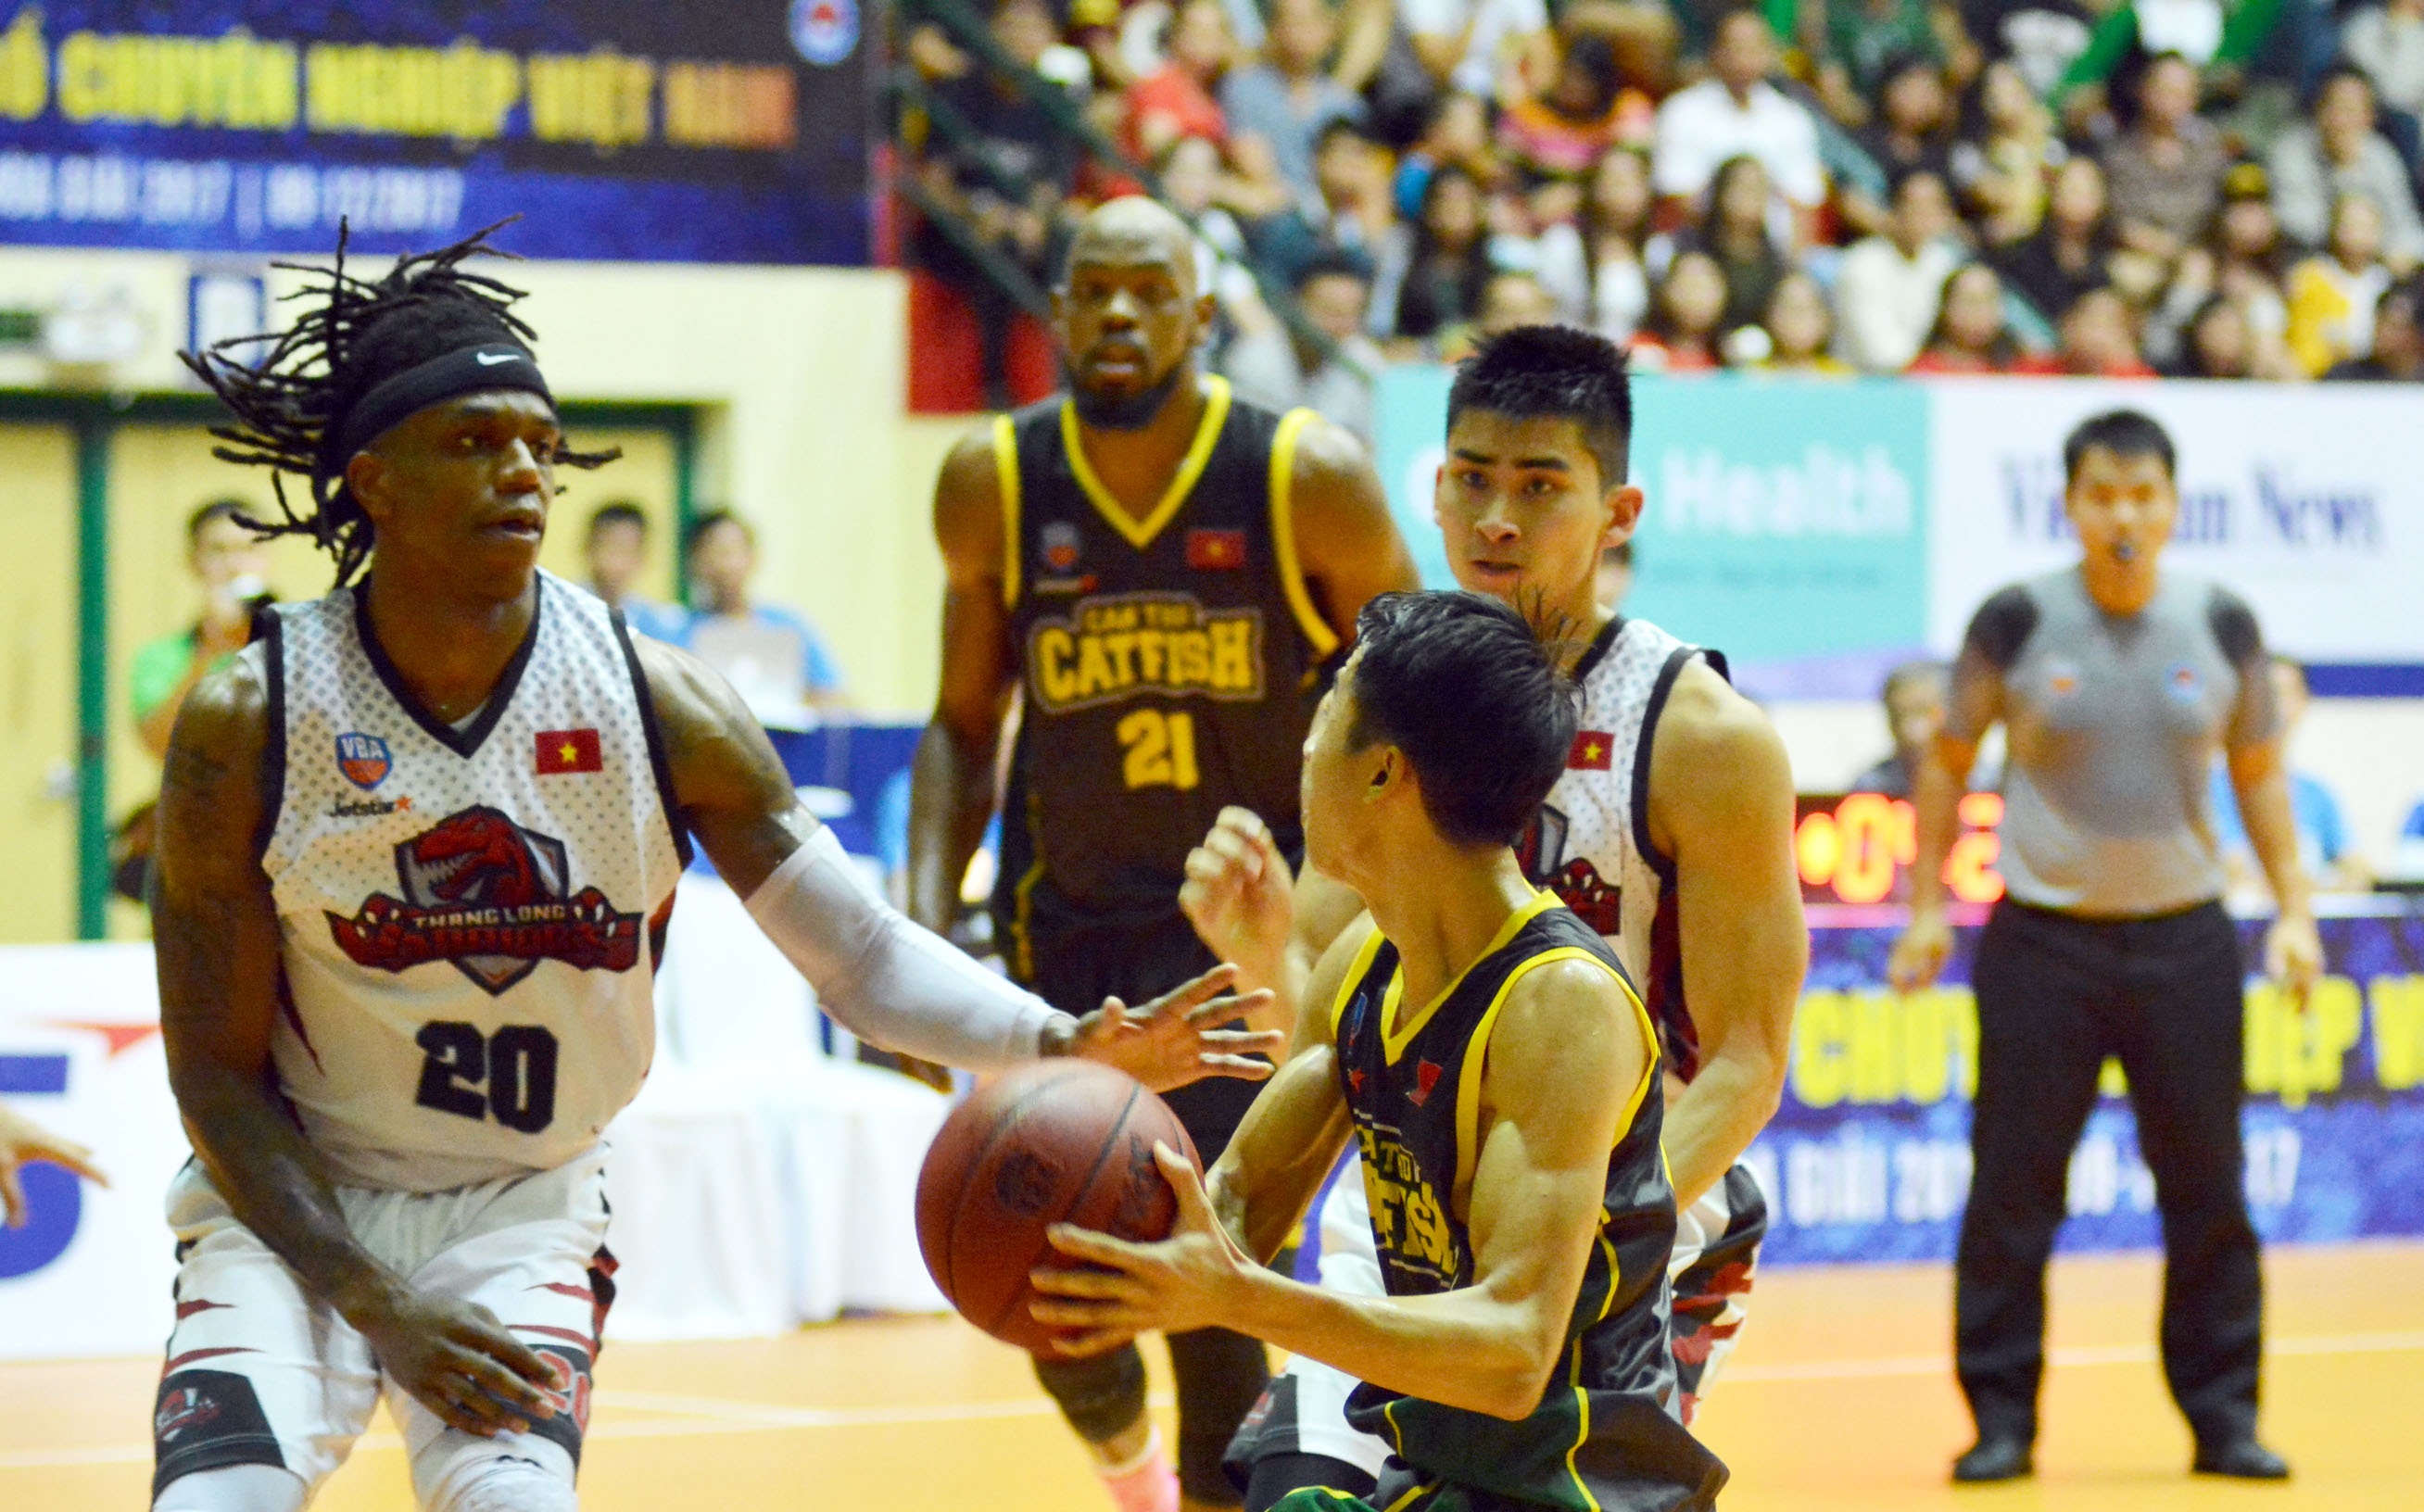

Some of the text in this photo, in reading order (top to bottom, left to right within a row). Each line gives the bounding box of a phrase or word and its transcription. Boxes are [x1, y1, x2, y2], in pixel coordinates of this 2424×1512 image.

[1664, 446, 1913, 536] Health
[2252, 461, 2385, 545] News
[1038, 620, 1253, 700] CATFISH
[341, 737, 385, 759] VBA
[1116, 708, 1200, 789] 21
[415, 1019, 560, 1134] 20
